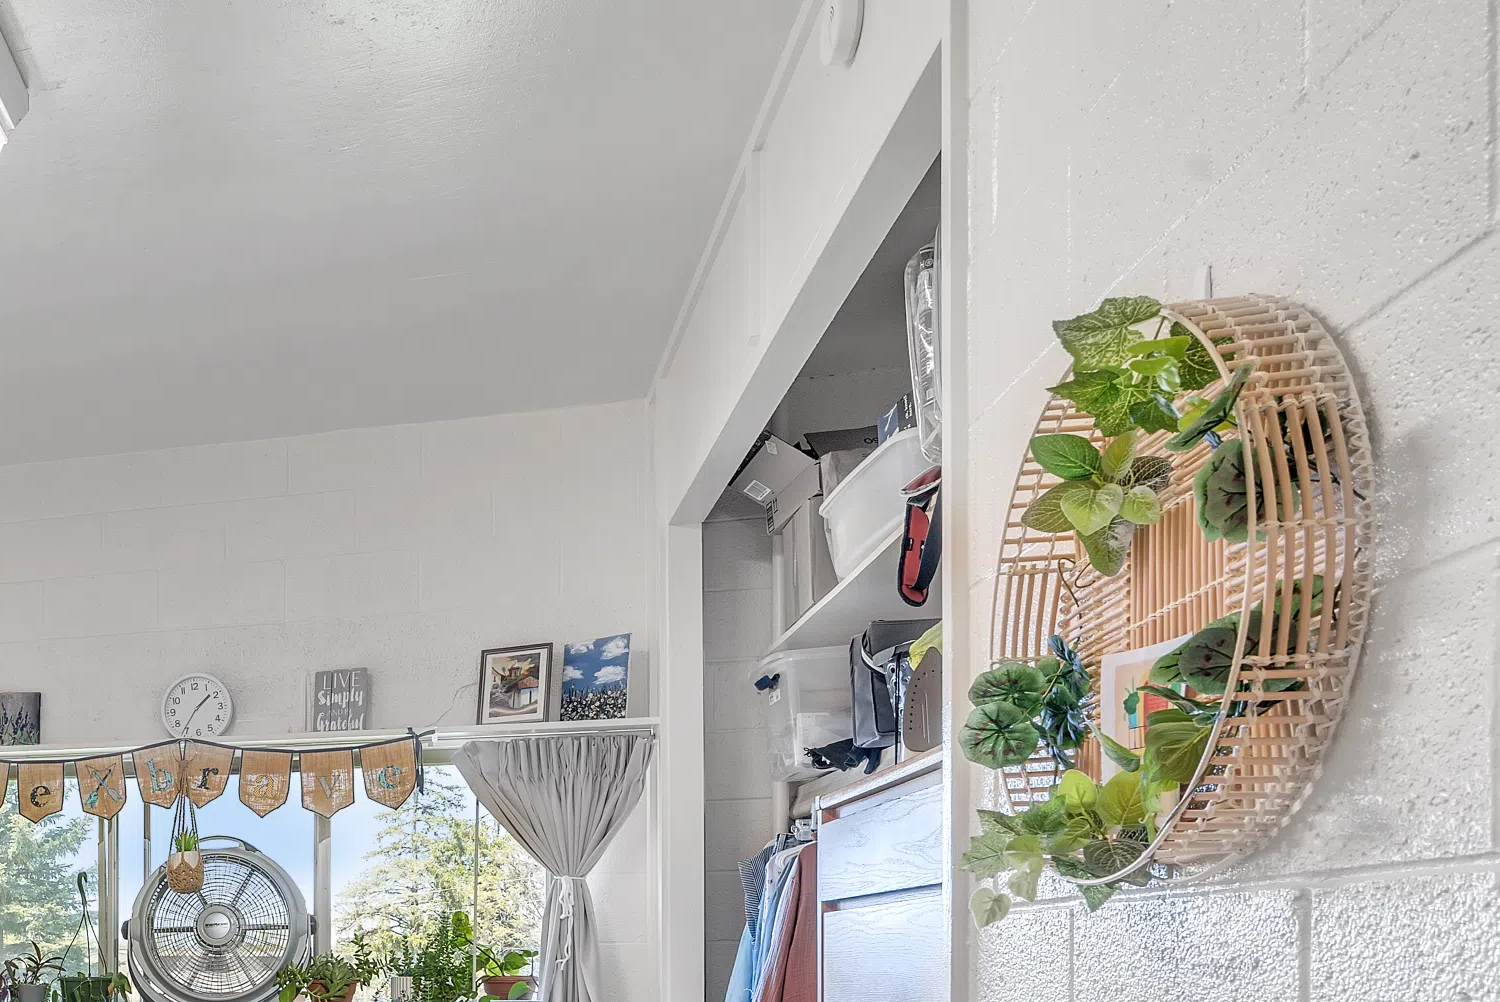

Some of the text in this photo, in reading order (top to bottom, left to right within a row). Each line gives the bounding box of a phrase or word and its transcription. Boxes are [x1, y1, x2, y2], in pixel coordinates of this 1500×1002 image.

[323, 671, 361, 689] LIVE
[190, 682, 199, 691] 12
[181, 687, 186, 695] 11
[212, 691, 219, 699] 2
[172, 697, 181, 705] 10
[317, 688, 363, 708] Simply
[217, 702, 224, 710] 3
[170, 708, 176, 717] 9
[215, 714, 221, 722] 4
[316, 712, 364, 731] Grateful
[174, 720, 181, 728] 8
[207, 724, 214, 732] 5
[184, 727, 190, 735] 7
[195, 728, 202, 737] 6
